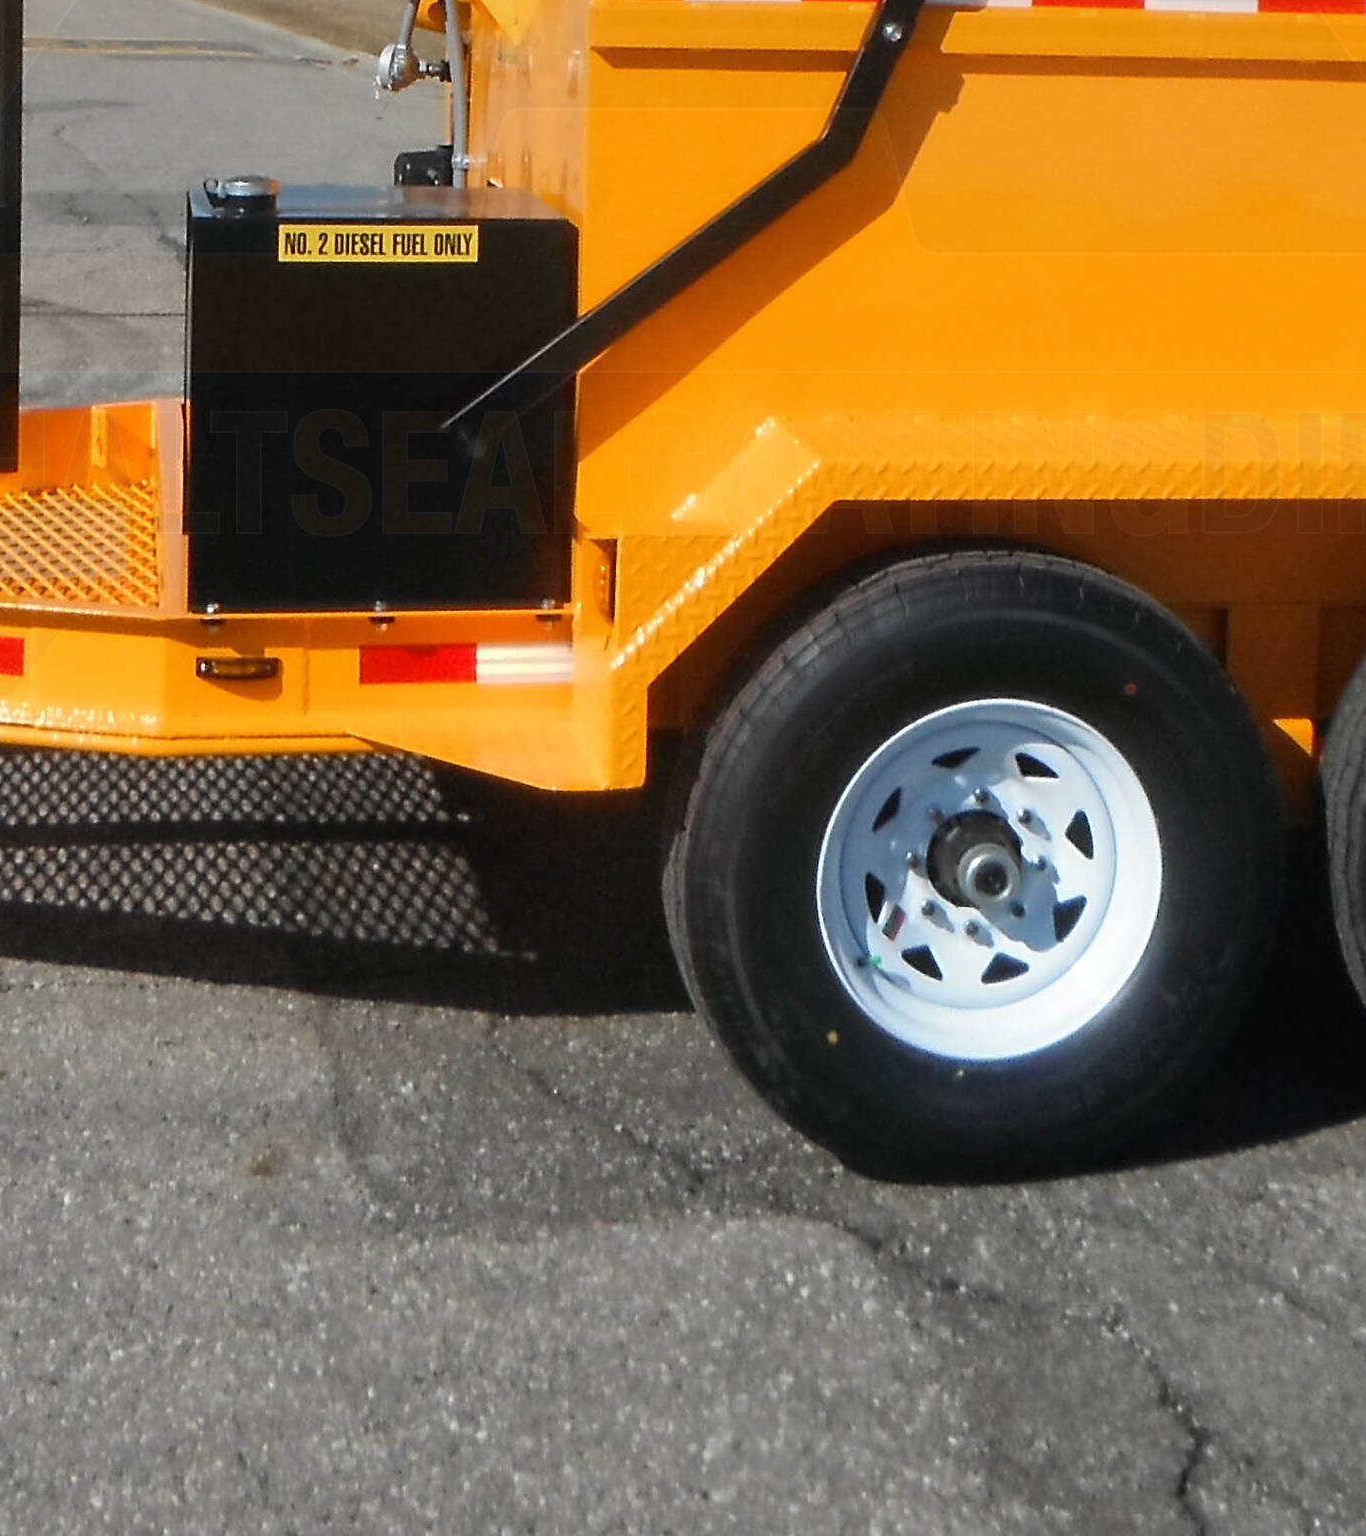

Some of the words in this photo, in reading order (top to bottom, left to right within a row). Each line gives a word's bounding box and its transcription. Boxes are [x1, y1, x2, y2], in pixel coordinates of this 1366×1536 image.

[284, 232, 312, 256] NO.
[318, 232, 329, 255] 2
[334, 232, 386, 256] DIESEL
[392, 233, 428, 256] FUEL
[433, 233, 473, 256] ONLY
